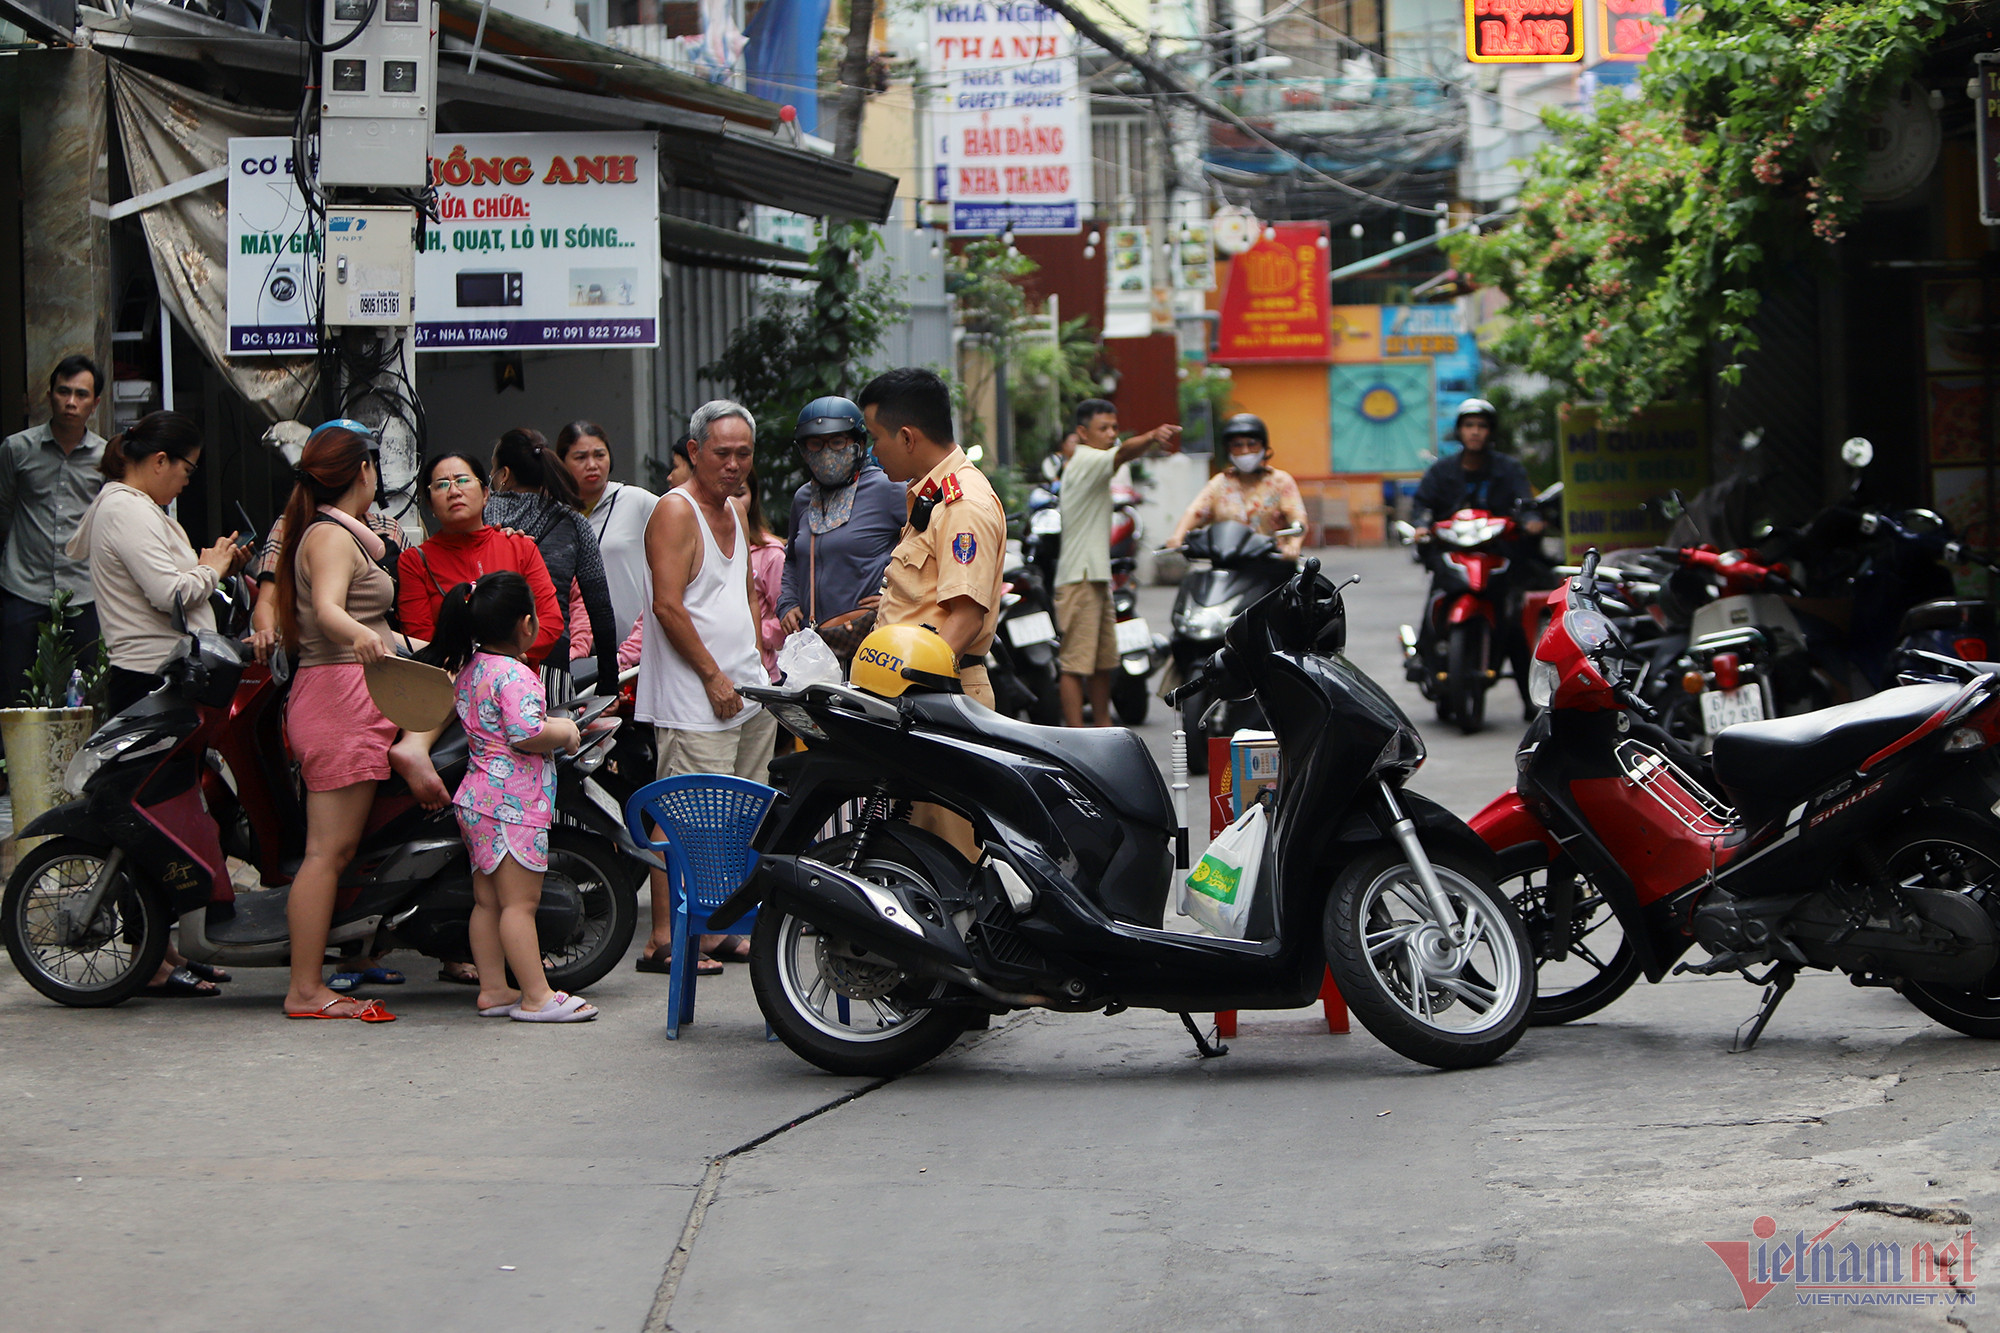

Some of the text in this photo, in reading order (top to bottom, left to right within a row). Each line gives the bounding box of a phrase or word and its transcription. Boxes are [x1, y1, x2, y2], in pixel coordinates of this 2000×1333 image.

[936, 36, 1057, 60] THANH
[343, 66, 404, 80] 2 3
[241, 155, 277, 175] CƠ
[542, 155, 638, 185] ANH
[959, 166, 999, 195] NHA
[1003, 165, 1070, 194] TRANG
[437, 192, 530, 218] ỬA CHỮA:
[241, 230, 284, 254] MÁY
[453, 229, 505, 254] QUẠT,
[511, 224, 534, 249] LÒ
[541, 228, 558, 249] VI
[565, 224, 636, 248] SÓNG...
[360, 298, 400, 313] 0905.115.161
[266, 331, 301, 346] 53/21
[439, 328, 465, 341] NHA
[468, 327, 508, 340] TRANG
[543, 326, 560, 339] ĐT:
[563, 325, 584, 338] 091
[588, 325, 610, 338] 822
[612, 324, 642, 338] 7245
[858, 647, 904, 673] CSGT
